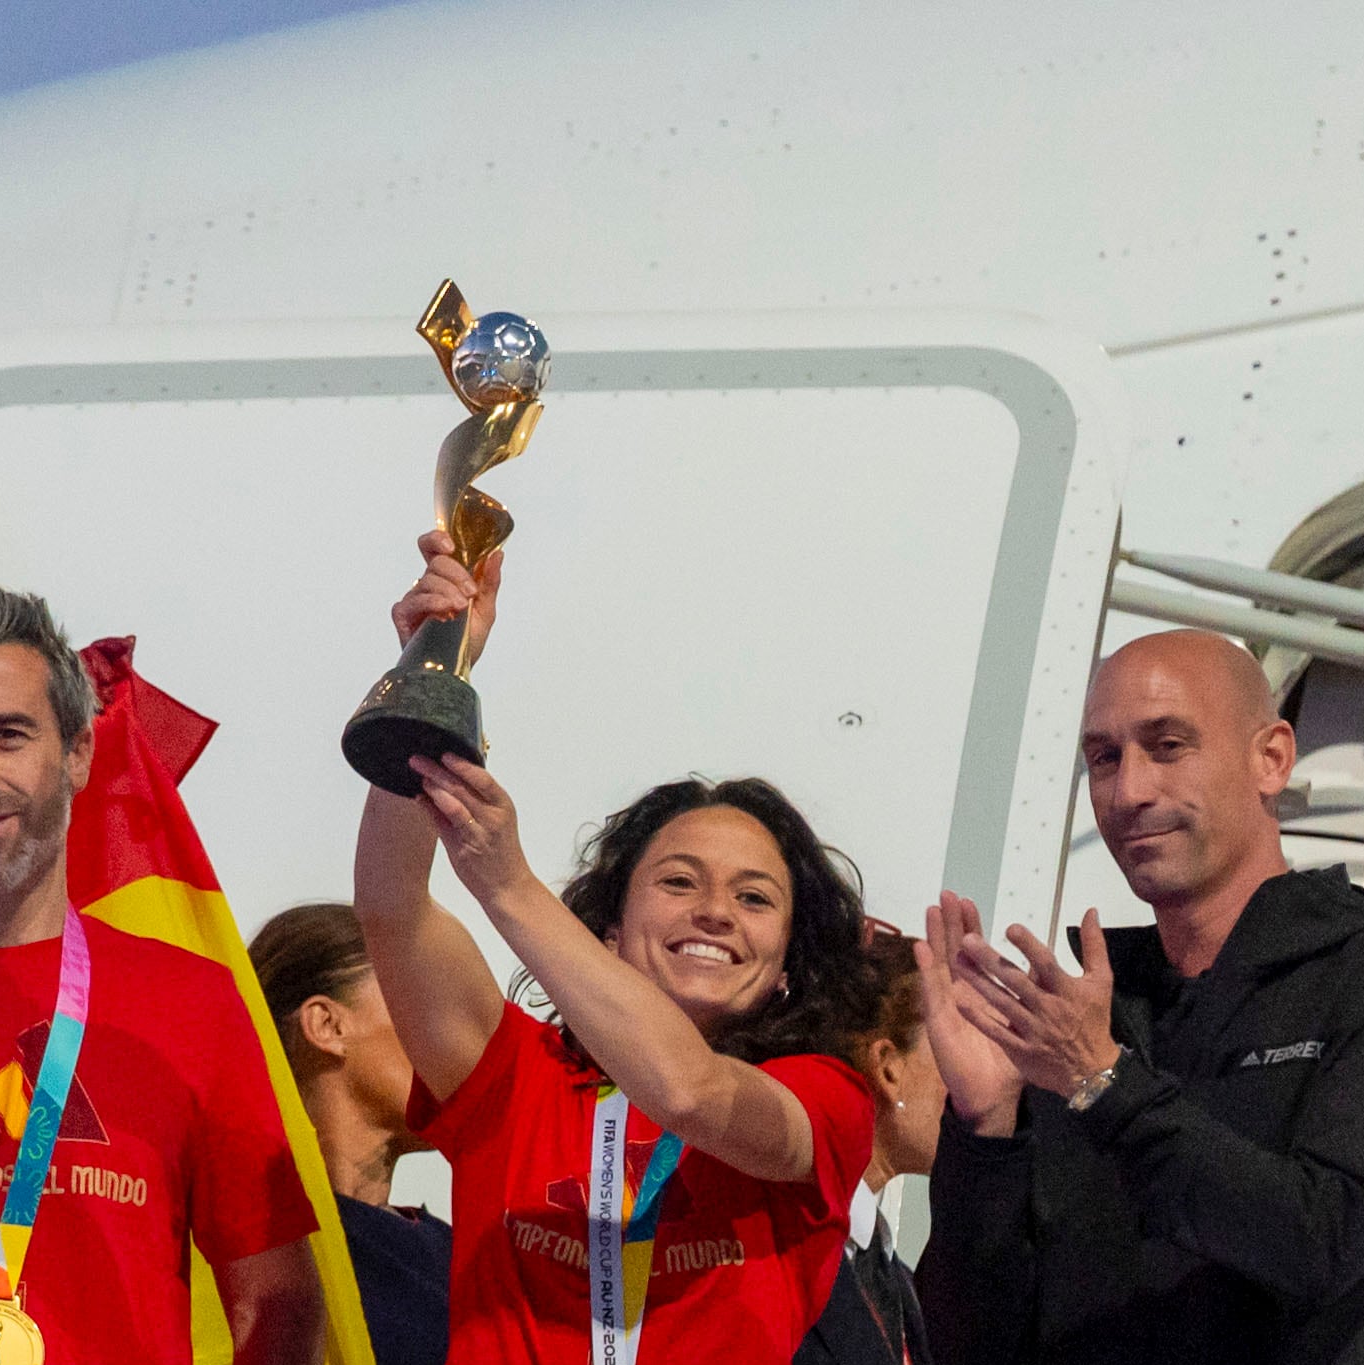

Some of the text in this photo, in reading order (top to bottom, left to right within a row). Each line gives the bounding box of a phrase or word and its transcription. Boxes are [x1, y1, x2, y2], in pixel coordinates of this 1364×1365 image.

[603, 1119, 616, 1143] FIFA
[71, 1165, 148, 1207] MUNDO
[601, 1142, 615, 1200] WOMEN'S
[599, 1201, 612, 1247] WORLD
[599, 1248, 613, 1279] CUP
[665, 1239, 745, 1274] MUNDO
